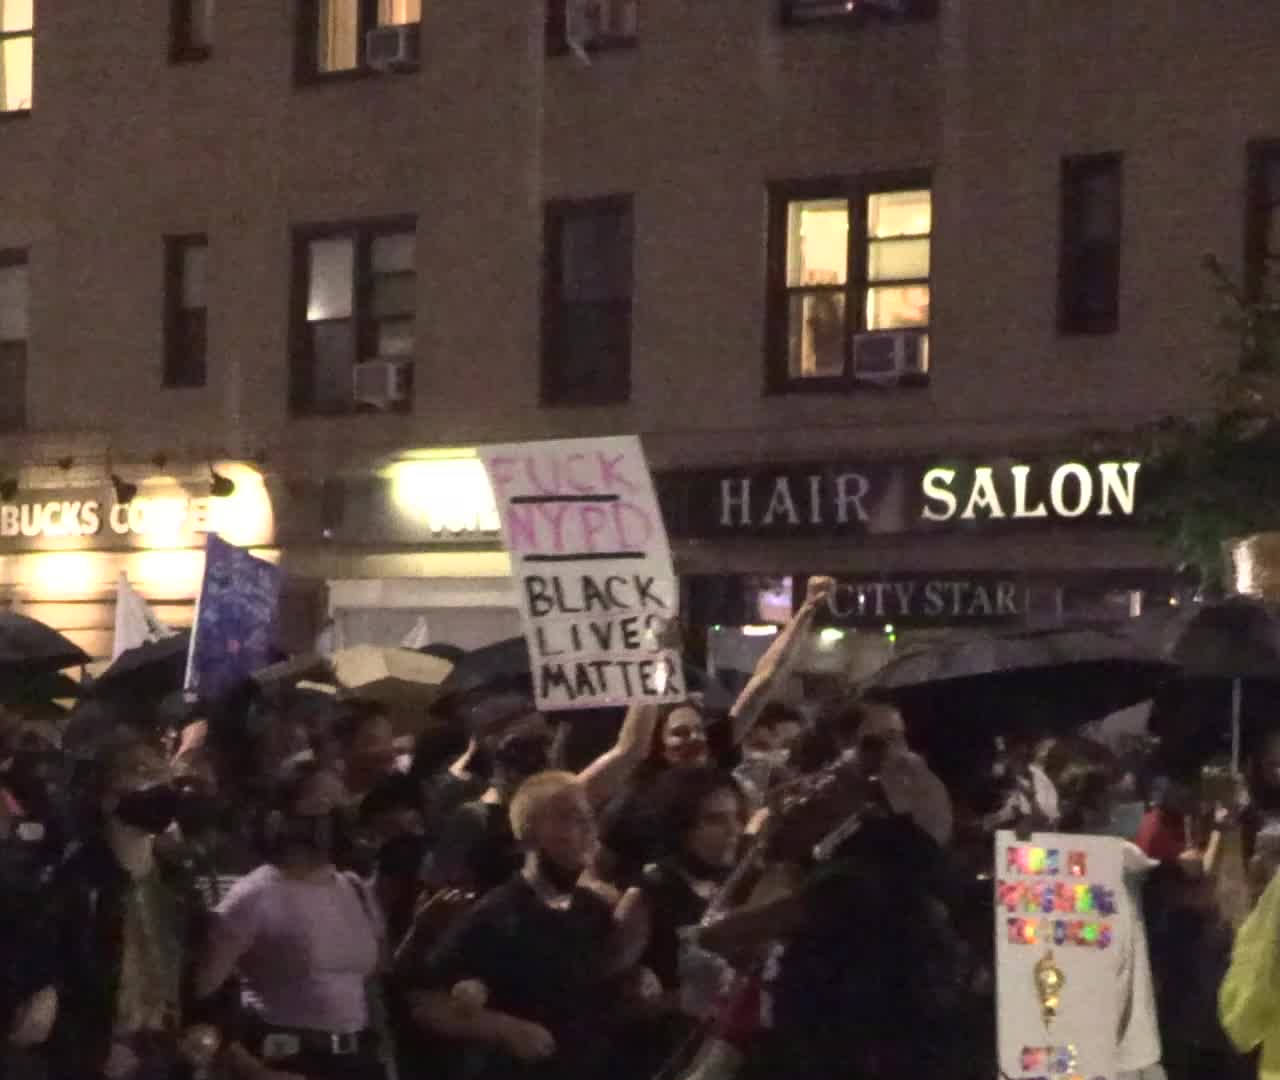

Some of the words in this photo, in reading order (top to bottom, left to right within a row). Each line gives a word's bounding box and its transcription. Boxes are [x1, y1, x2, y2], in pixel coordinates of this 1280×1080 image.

[491, 453, 633, 497] FUCK
[720, 473, 870, 526] HAIR
[922, 462, 1141, 521] SALON
[507, 502, 655, 551] NYPD
[524, 574, 666, 617] BLACK
[924, 582, 1019, 616] STAR
[539, 658, 680, 699] MATTER
